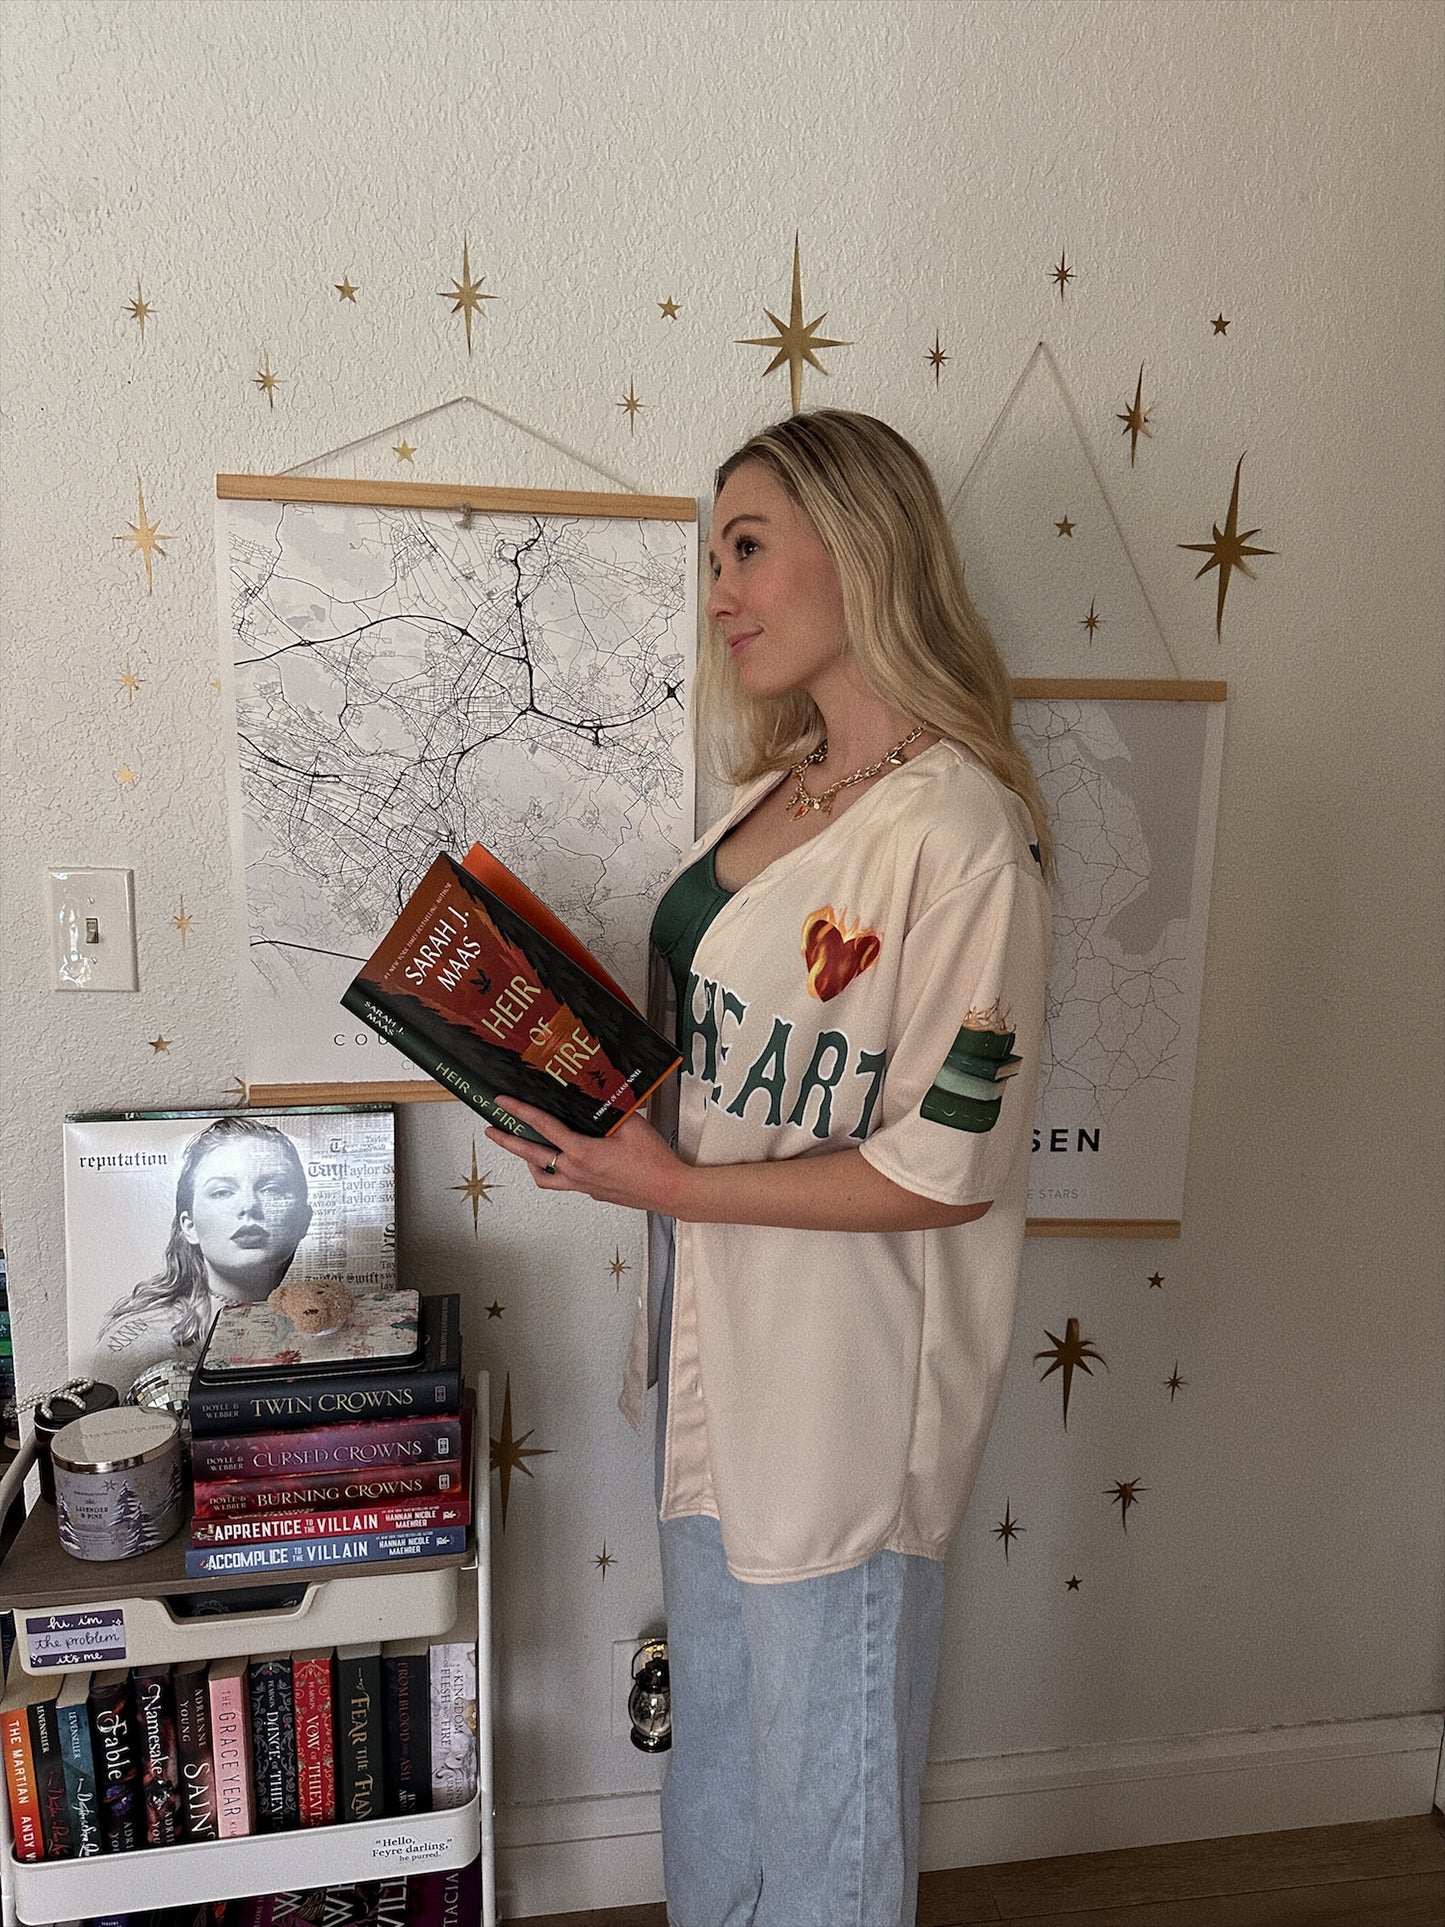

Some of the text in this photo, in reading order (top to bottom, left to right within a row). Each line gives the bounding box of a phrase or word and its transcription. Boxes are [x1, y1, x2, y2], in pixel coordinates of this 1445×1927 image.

[404, 906, 470, 986] SARAH J.
[437, 935, 481, 992] MAAS
[363, 1000, 397, 1028] SARAH
[481, 975, 542, 1040] HEIR
[366, 1013, 395, 1036] MAAS
[529, 1016, 554, 1046] OF
[544, 1027, 601, 1088] FIRE
[435, 1062, 471, 1094] HEIR
[472, 1094, 490, 1108] OF
[492, 1108, 526, 1136] FIRE
[79, 1152, 168, 1170] reputation
[1039, 1189, 1079, 1199] STARS
[202, 1404, 231, 1412] DOYLE
[206, 1411, 240, 1419] WEBBER
[250, 1388, 414, 1417] TWIN CROWNS
[206, 1457, 234, 1465] DOYLE
[210, 1464, 244, 1472] WEBBER
[253, 1440, 423, 1470] CURSED CROWNS
[209, 1497, 236, 1505] DOYLE
[257, 1479, 423, 1507] BURNING CROWNS
[213, 1503, 247, 1511] WEBBER
[385, 1512, 412, 1521] HANNAH
[414, 1510, 436, 1519] NICOLE
[214, 1519, 303, 1541] APPRENTICE
[304, 1526, 316, 1534] THE
[305, 1519, 314, 1527] TO
[317, 1514, 379, 1533] VILLAIN
[395, 1519, 427, 1528] MAEHRER
[293, 1547, 302, 1555] TO
[306, 1541, 368, 1561] VILLAIN
[379, 1536, 430, 1548] HANNAH NICOLE
[389, 1546, 421, 1555] MAEHRER
[208, 1548, 289, 1571] ACCOMPLICE
[35, 1631, 120, 1650] the problem
[56, 1652, 103, 1664] it's me
[397, 1661, 409, 1697] FROM
[440, 1669, 451, 1703] FLESH
[221, 1690, 232, 1706] THE
[453, 1675, 465, 1734] KINGDOM
[36, 1705, 50, 1753] LEVENSELLER
[141, 1683, 170, 1775] Namesake
[180, 1701, 191, 1743] YOUNG
[194, 1689, 206, 1748] ADRIENNE
[348, 1692, 370, 1745] FEAR
[399, 1700, 410, 1744] BLOOD
[8, 1720, 22, 1744] THE
[68, 1711, 81, 1759] LEVENSELLER
[96, 1710, 131, 1780] Fable
[218, 1712, 239, 1770] GRACE
[264, 1711, 281, 1760] DANCE
[306, 1715, 321, 1750] VOW
[440, 1720, 451, 1746] FIRE
[356, 1746, 369, 1772] THE
[400, 1759, 410, 1781] ASH
[12, 1750, 29, 1804] MARTIAN
[183, 1762, 215, 1838] SAIN
[222, 1775, 241, 1817] YEAR
[21, 1816, 35, 1848] ANDY
[372, 1848, 403, 1858] Feyre
[411, 1851, 441, 1862] purred.
